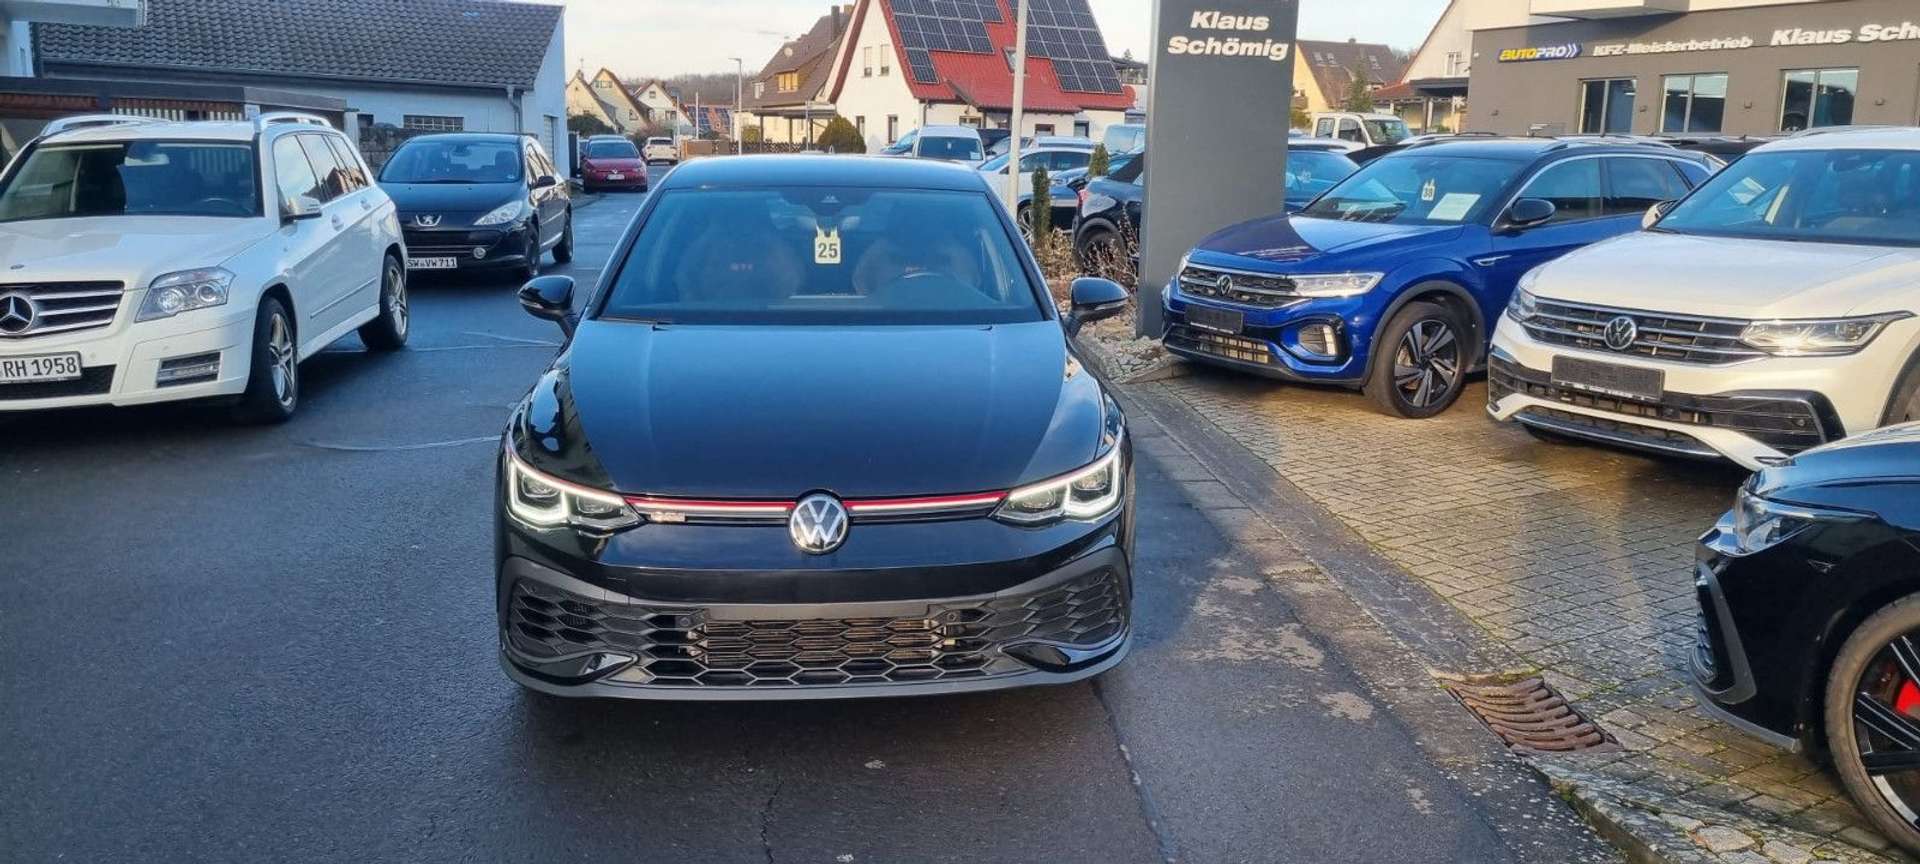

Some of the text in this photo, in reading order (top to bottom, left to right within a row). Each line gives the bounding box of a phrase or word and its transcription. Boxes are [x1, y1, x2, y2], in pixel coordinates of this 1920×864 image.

[1190, 11, 1270, 31] Klaus
[1771, 21, 1920, 46] Klaus Sch
[1167, 36, 1289, 61] Schömig
[1499, 45, 1567, 60] AUTOPRO
[1593, 36, 1753, 56] KFZ-Meisterbetrieb
[818, 242, 838, 258] 25
[3, 356, 77, 377] RH 1958
